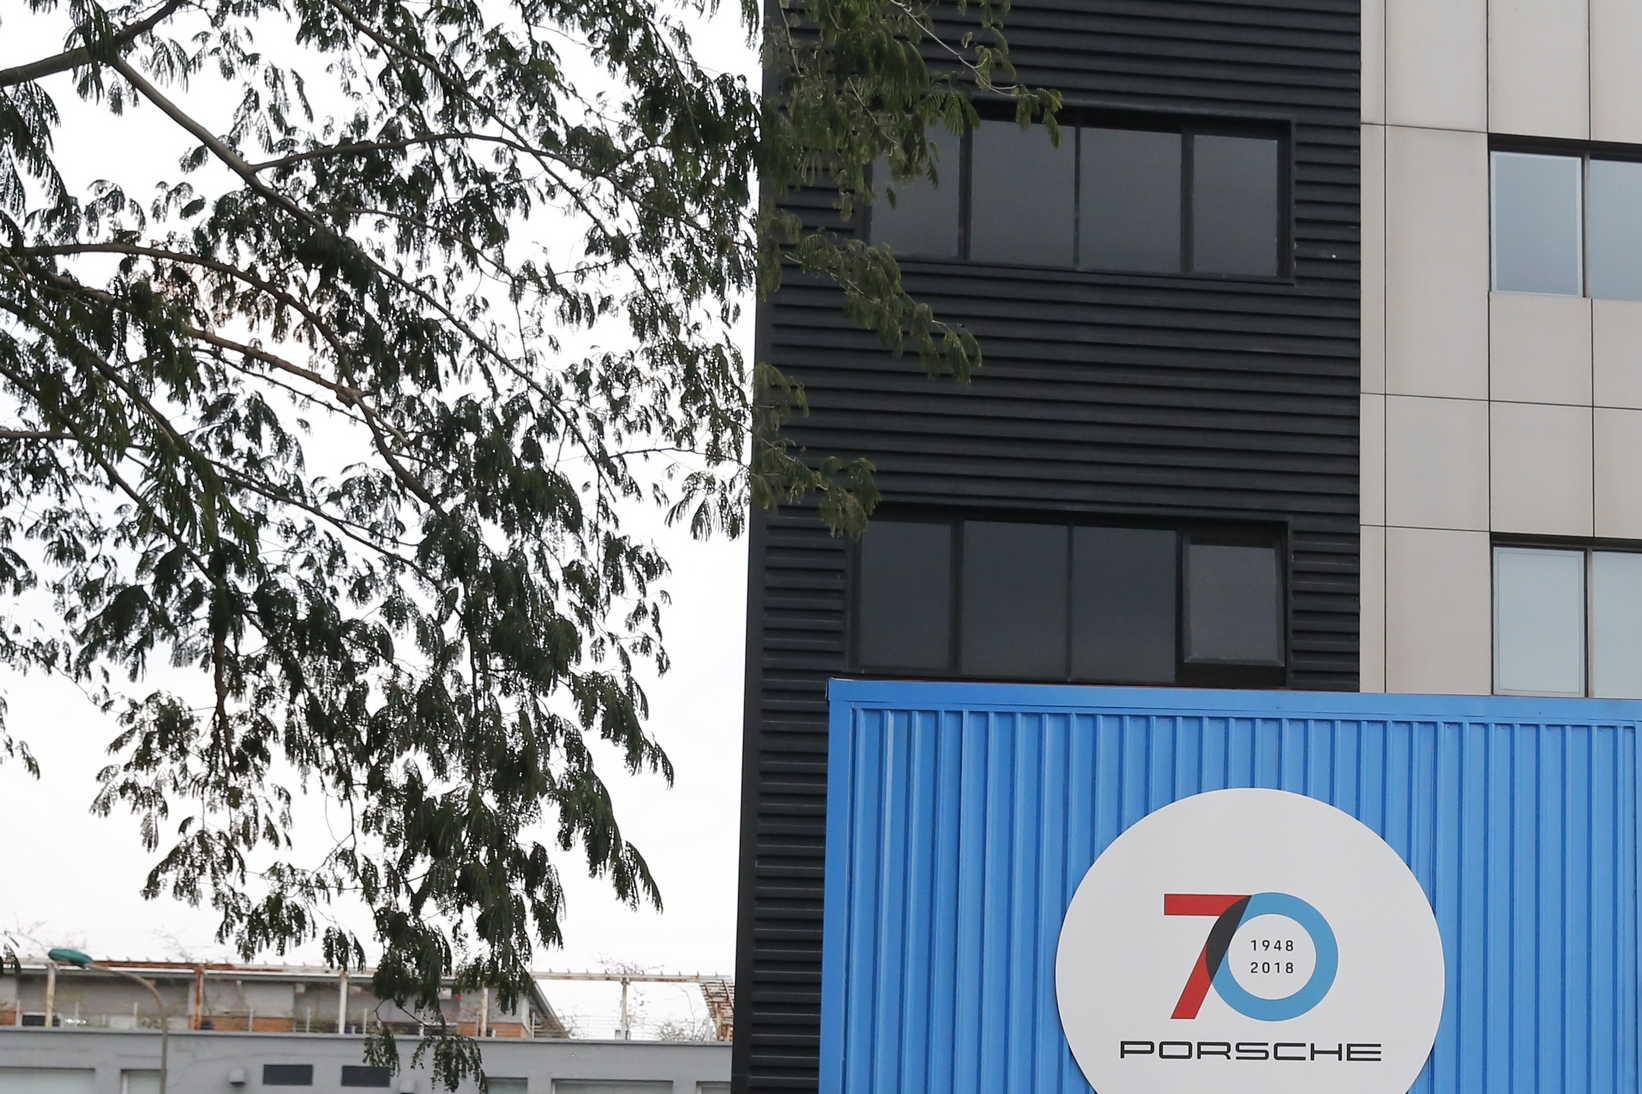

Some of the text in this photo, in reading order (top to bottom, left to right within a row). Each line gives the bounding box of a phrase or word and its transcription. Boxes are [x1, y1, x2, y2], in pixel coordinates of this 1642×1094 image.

[1250, 940, 1294, 952] 1948
[1164, 892, 1338, 1021] 70
[1250, 962, 1294, 974] 2018
[1120, 1040, 1382, 1062] PORSCHE
